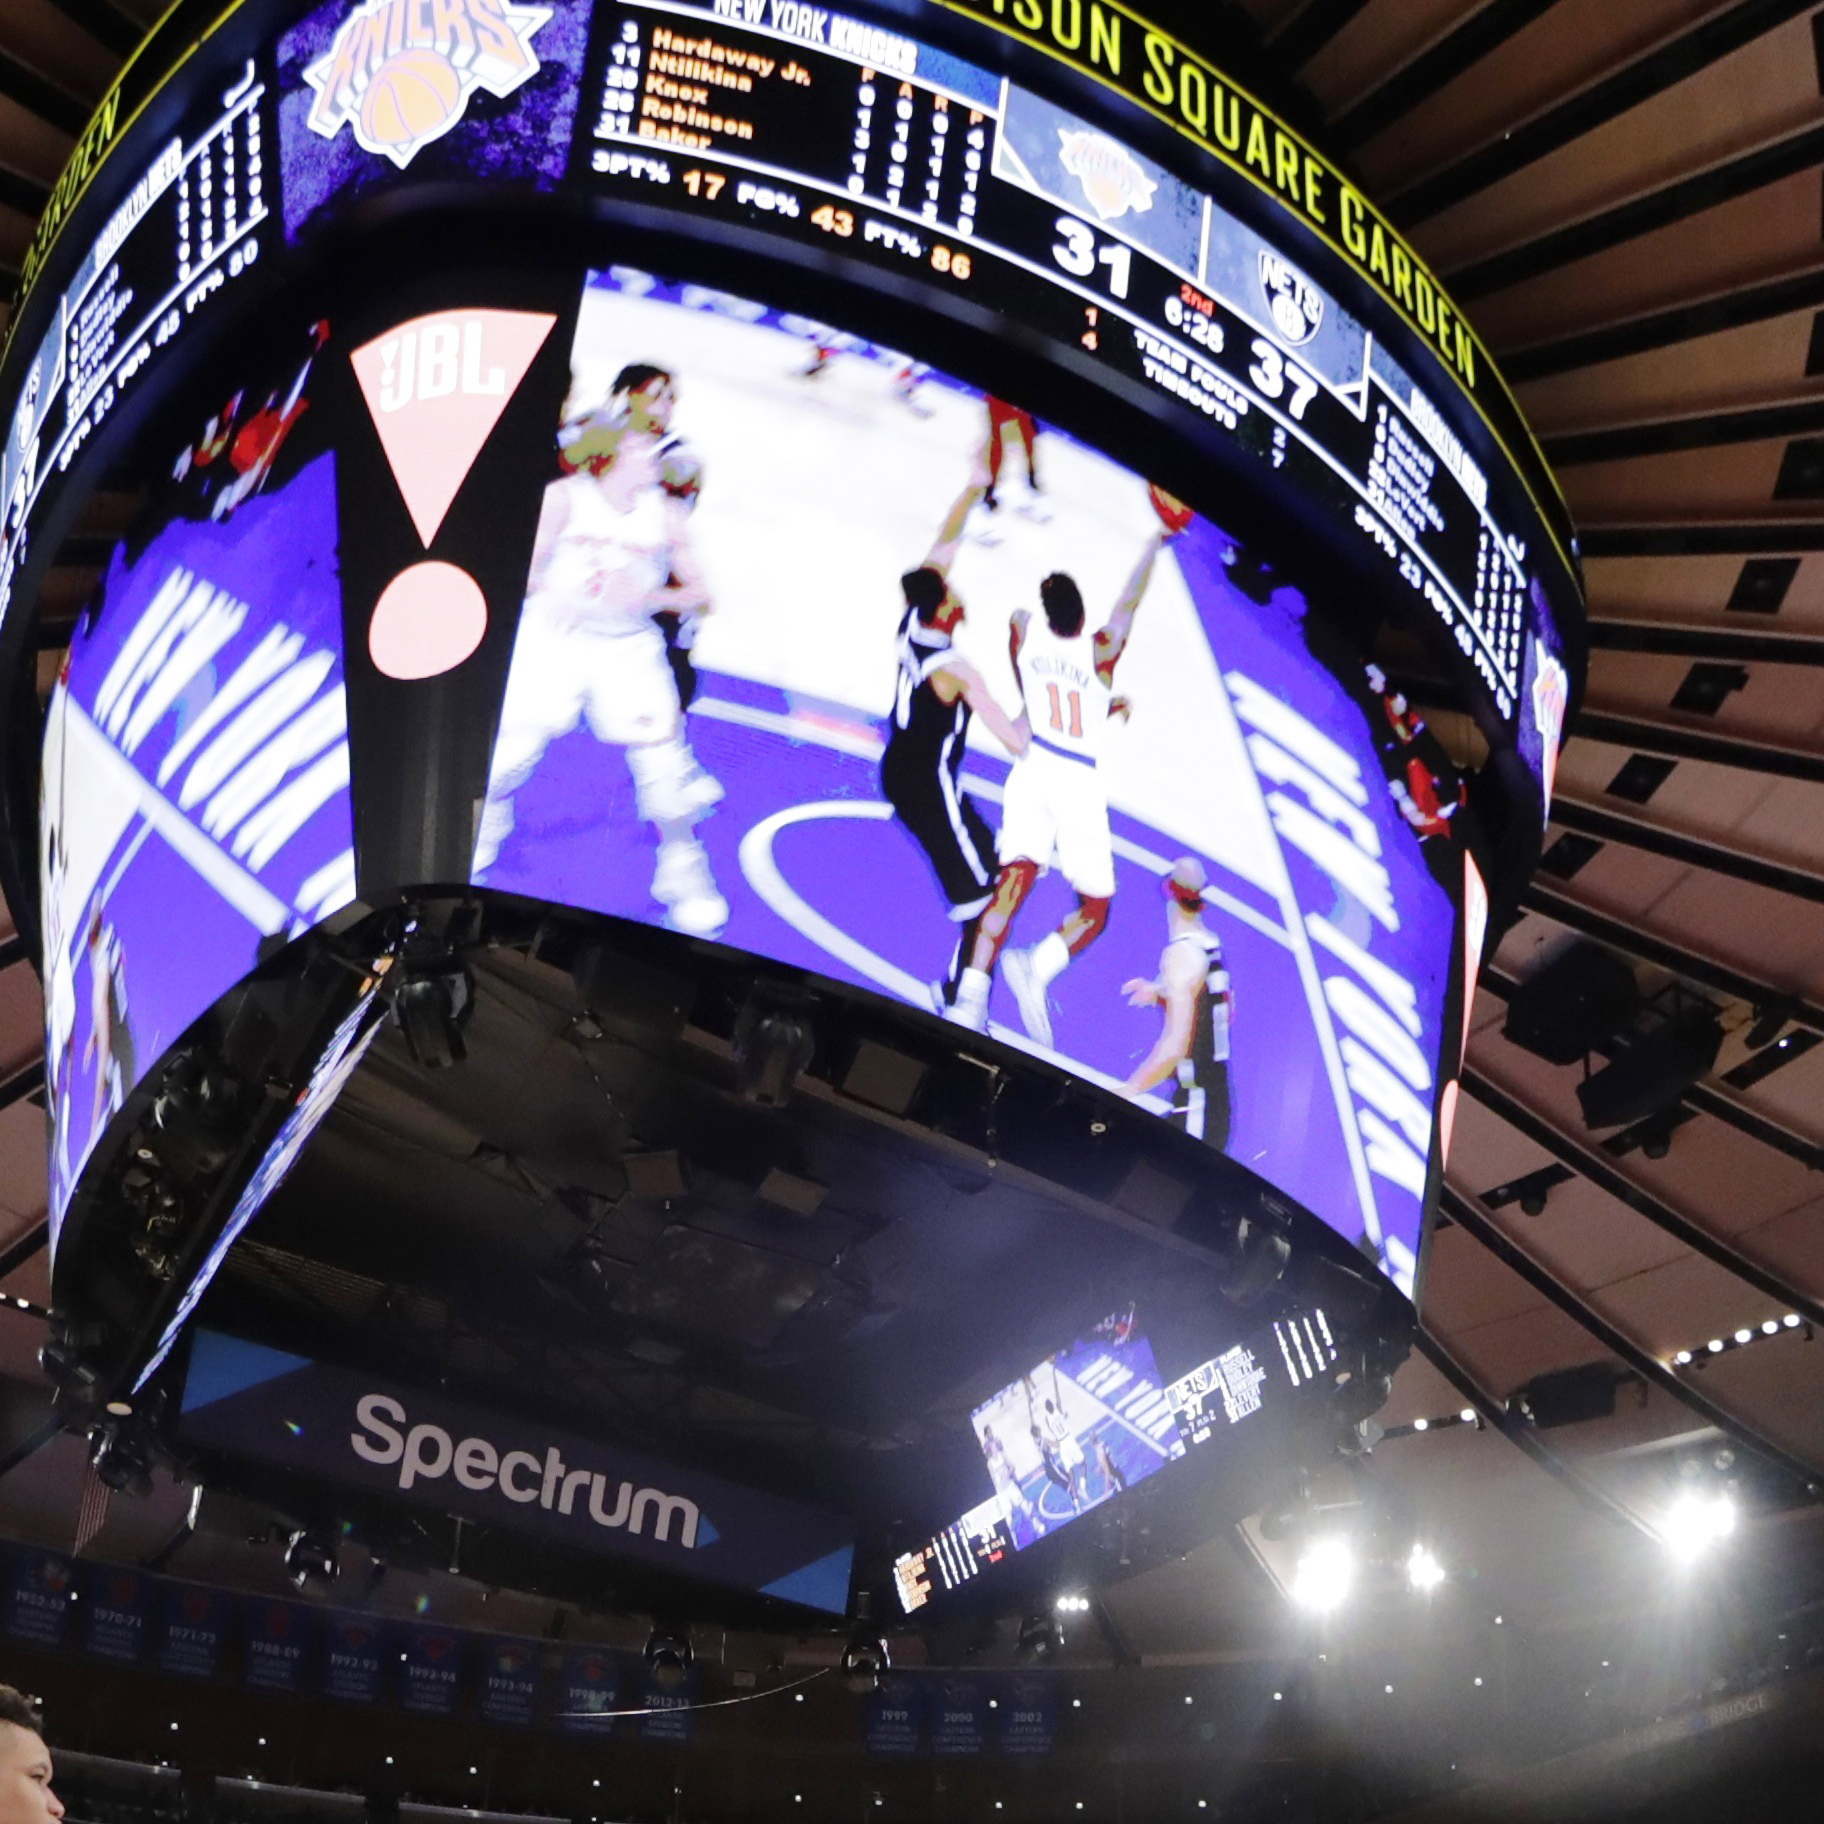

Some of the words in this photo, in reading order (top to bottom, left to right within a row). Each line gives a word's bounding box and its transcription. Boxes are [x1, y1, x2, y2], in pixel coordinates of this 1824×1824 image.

[610, 42, 642, 68] 11
[621, 21, 640, 43] 3
[652, 26, 776, 78] Hardaway
[780, 60, 812, 87] Jr.
[769, 0, 828, 43] YORK
[829, 15, 918, 75] KNICKS
[606, 65, 640, 90] 20
[644, 73, 710, 105] Knox
[641, 96, 754, 140] Robinson
[637, 118, 712, 151] Baker
[591, 149, 671, 185] 3PT%
[682, 169, 726, 200] 17
[736, 181, 800, 218] FG%
[810, 204, 854, 237] 43
[863, 219, 921, 258] FT%
[930, 244, 972, 280] 86
[1142, 34, 1326, 224] SQUARE
[1340, 186, 1476, 388] GARDEN
[229, 236, 259, 277] 80
[1051, 216, 1132, 300] 31
[1180, 282, 1215, 318] 2nd
[1261, 255, 1321, 325] NETS
[1164, 295, 1225, 354] 6:28
[380, 320, 507, 413] JBL
[1080, 330, 1098, 351] 4
[1142, 357, 1237, 430] TIMEOUTS
[1084, 306, 1098, 327] 1
[1133, 328, 1188, 375] TEAM
[1190, 363, 1249, 416] FOULS
[1272, 427, 1287, 449] 2
[1248, 338, 1319, 421] 37
[1399, 552, 1423, 589] 23
[1045, 682, 1085, 739] 11
[1185, 1399, 1203, 1421] 37
[350, 1394, 701, 1550] Spectrum
